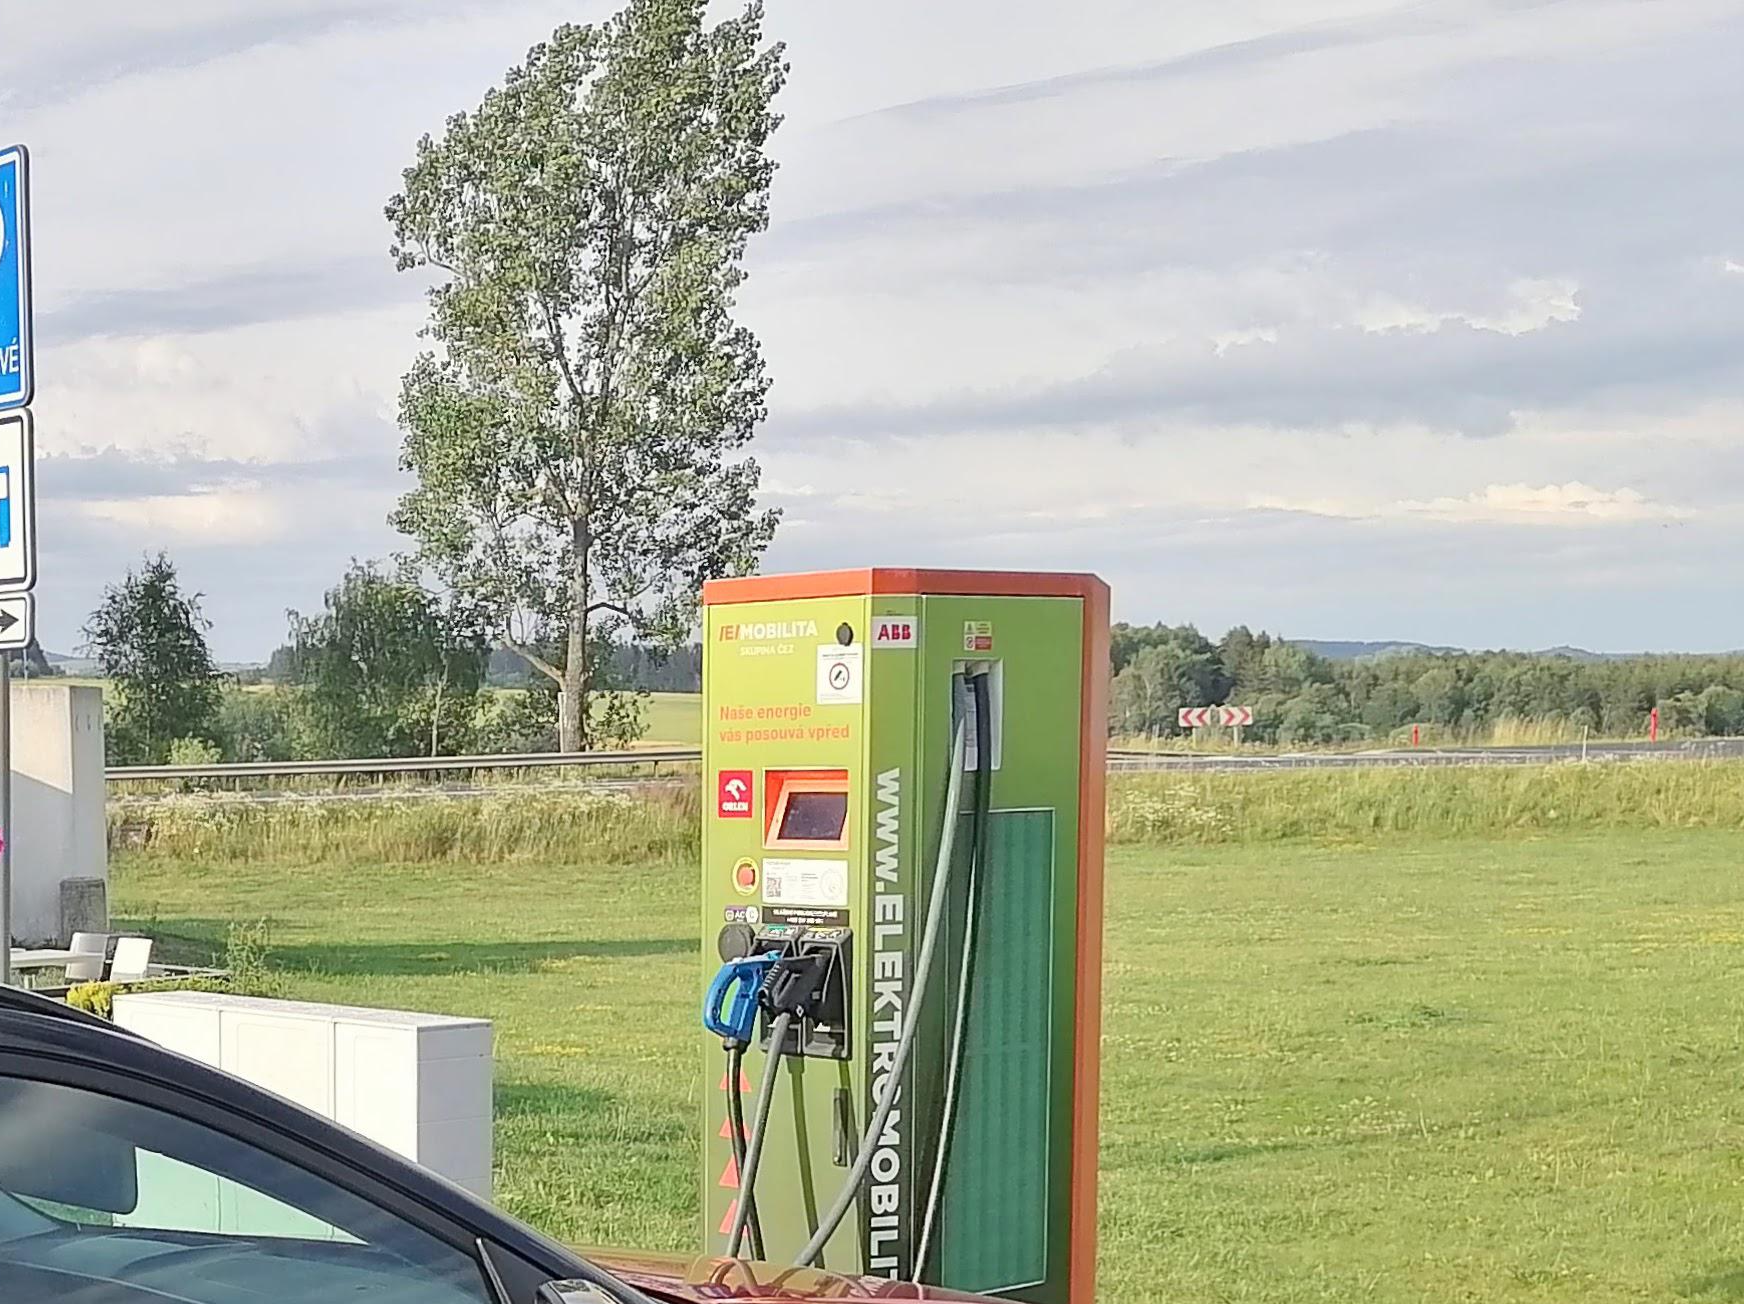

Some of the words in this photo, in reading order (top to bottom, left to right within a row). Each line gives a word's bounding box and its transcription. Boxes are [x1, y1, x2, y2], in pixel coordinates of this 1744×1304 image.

[877, 623, 912, 641] ABB
[777, 643, 795, 655] ČEZ
[720, 704, 754, 721] Naše
[757, 704, 812, 721] energie
[720, 727, 742, 742] vás
[746, 723, 805, 744] posouvá
[809, 723, 850, 742] vpřed
[721, 801, 749, 812] ORLEN
